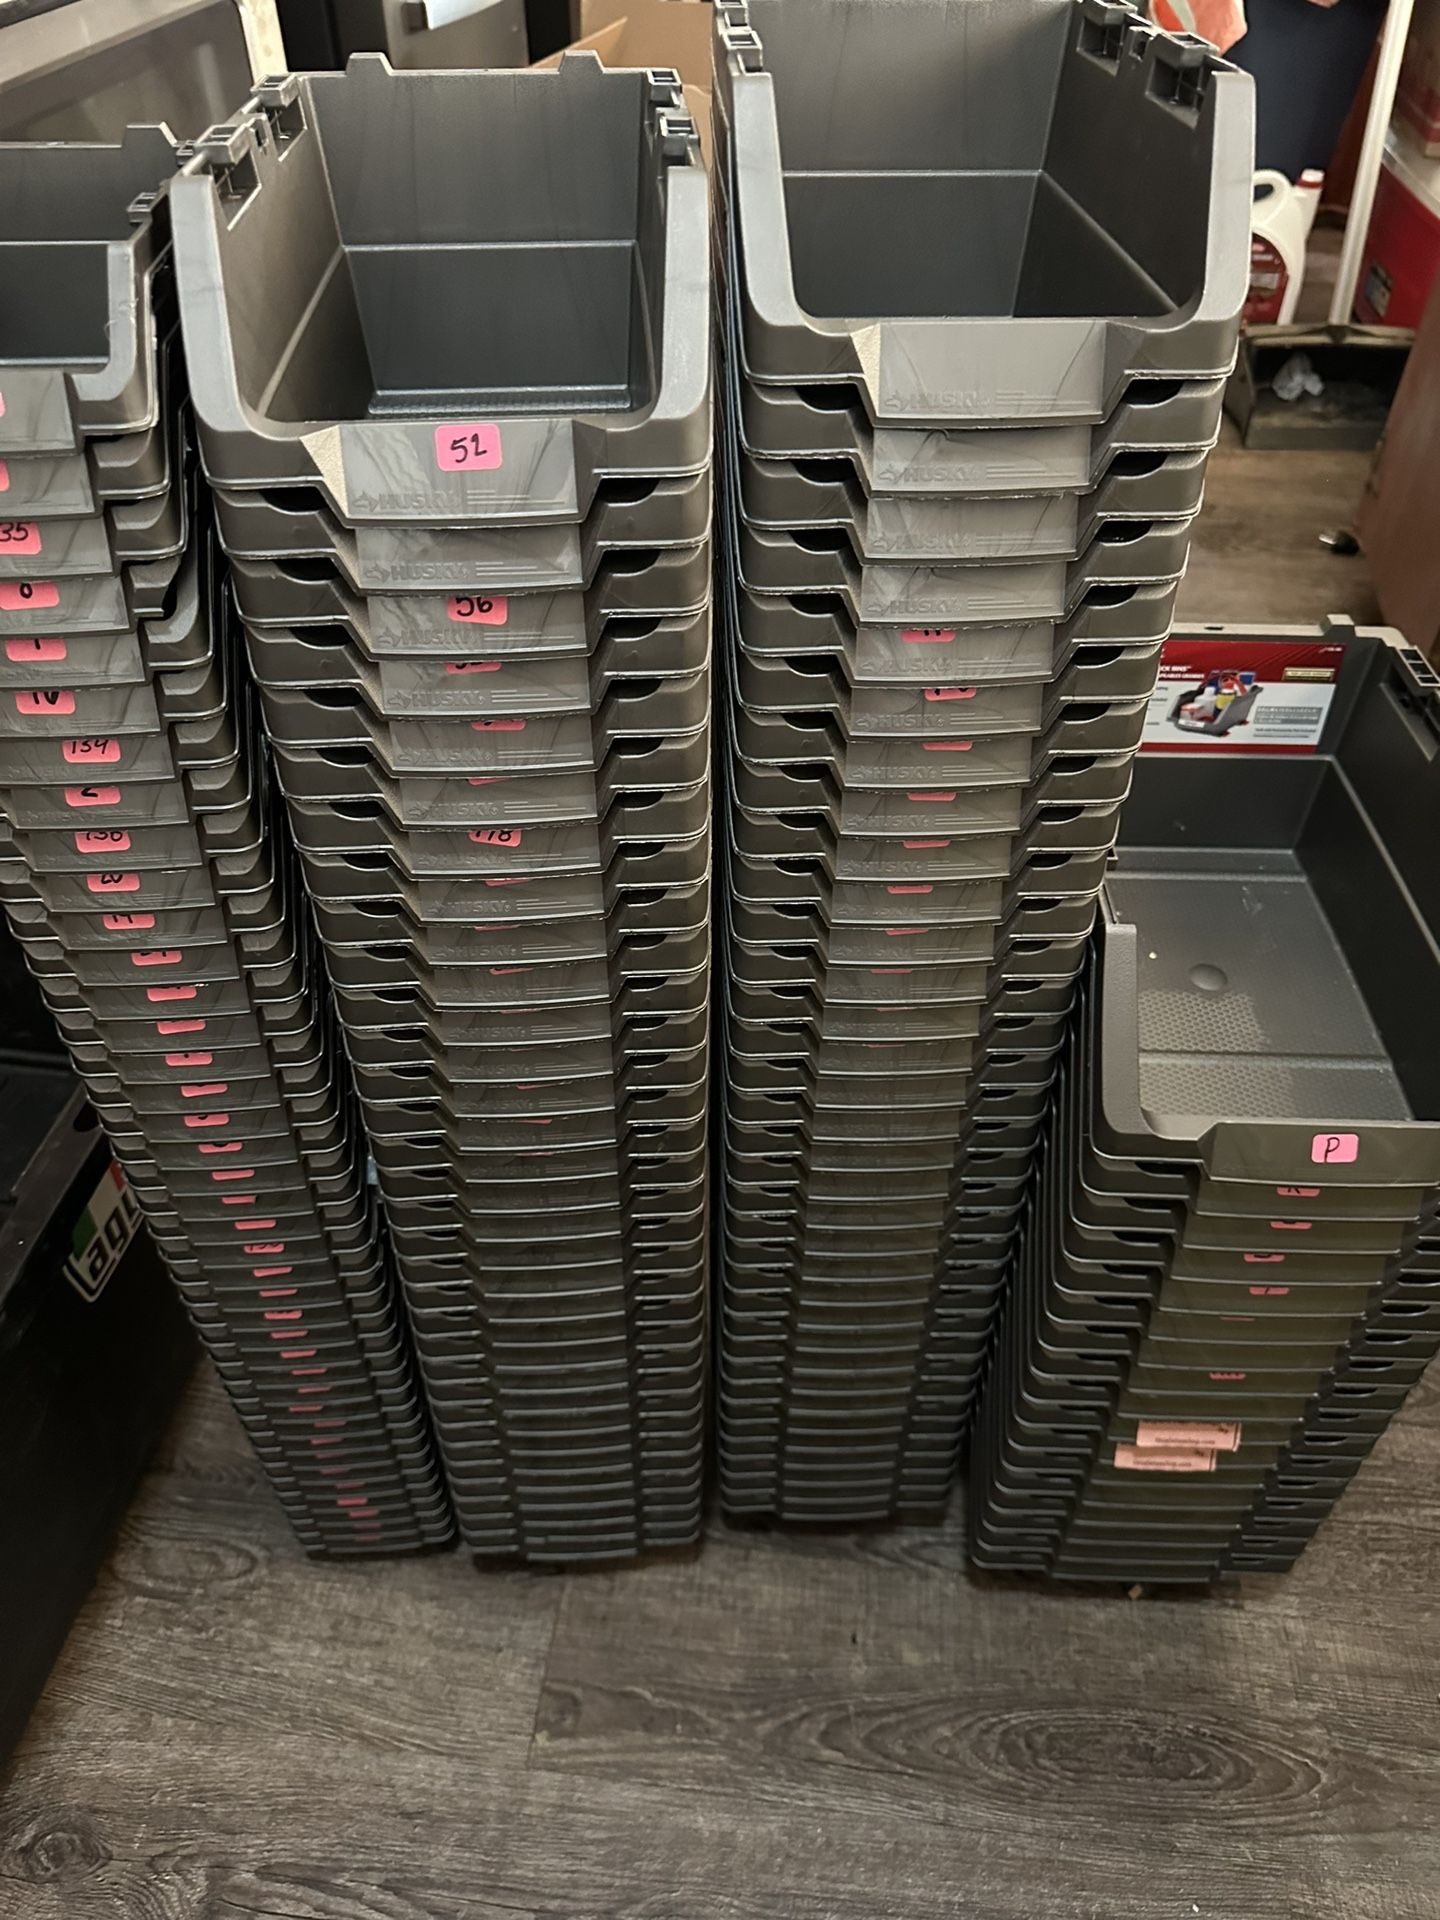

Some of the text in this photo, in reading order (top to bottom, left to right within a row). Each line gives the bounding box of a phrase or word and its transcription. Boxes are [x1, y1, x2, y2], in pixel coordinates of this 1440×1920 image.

[449, 432, 488, 463] 52
[903, 464, 970, 483] HUSKY
[390, 561, 463, 581] HUSKY
[1324, 1136, 1341, 1163] P
